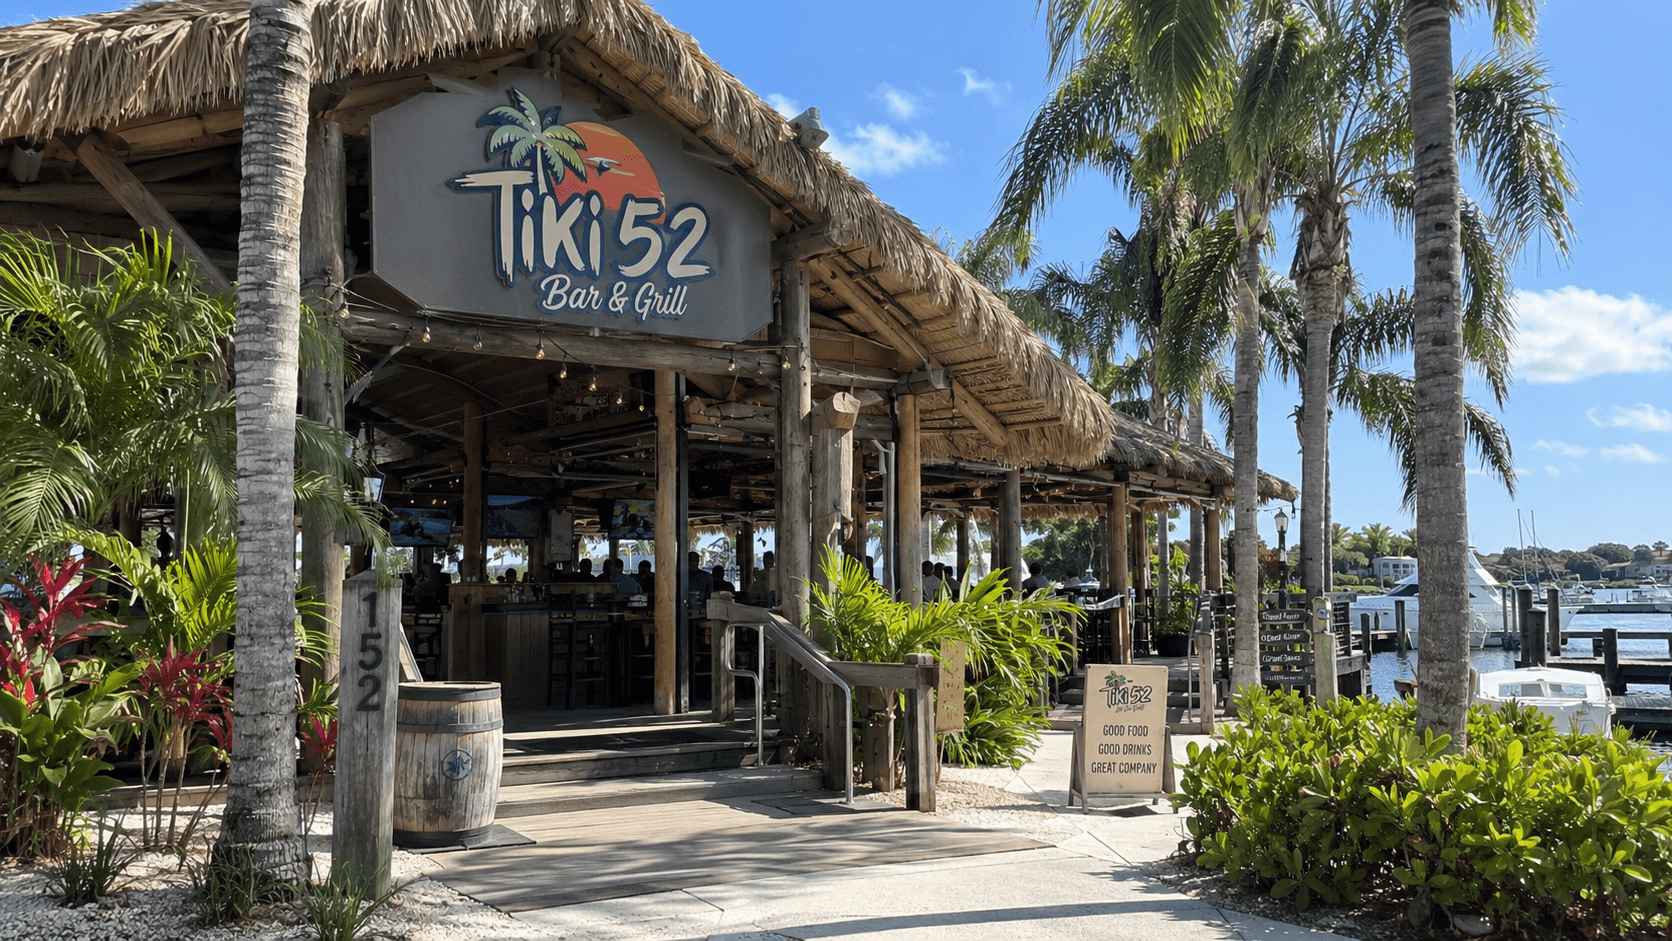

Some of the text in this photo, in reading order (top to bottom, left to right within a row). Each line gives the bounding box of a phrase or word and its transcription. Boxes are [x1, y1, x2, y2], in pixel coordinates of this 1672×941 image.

[618, 198, 711, 279] 52
[540, 274, 688, 321] Bar & Grill
[1130, 685, 1152, 704] 52
[1103, 725, 1149, 737] GOOD FOOD
[1098, 743, 1152, 755] GOOD DRINKS
[1091, 761, 1158, 774] GREAT COMPANY
